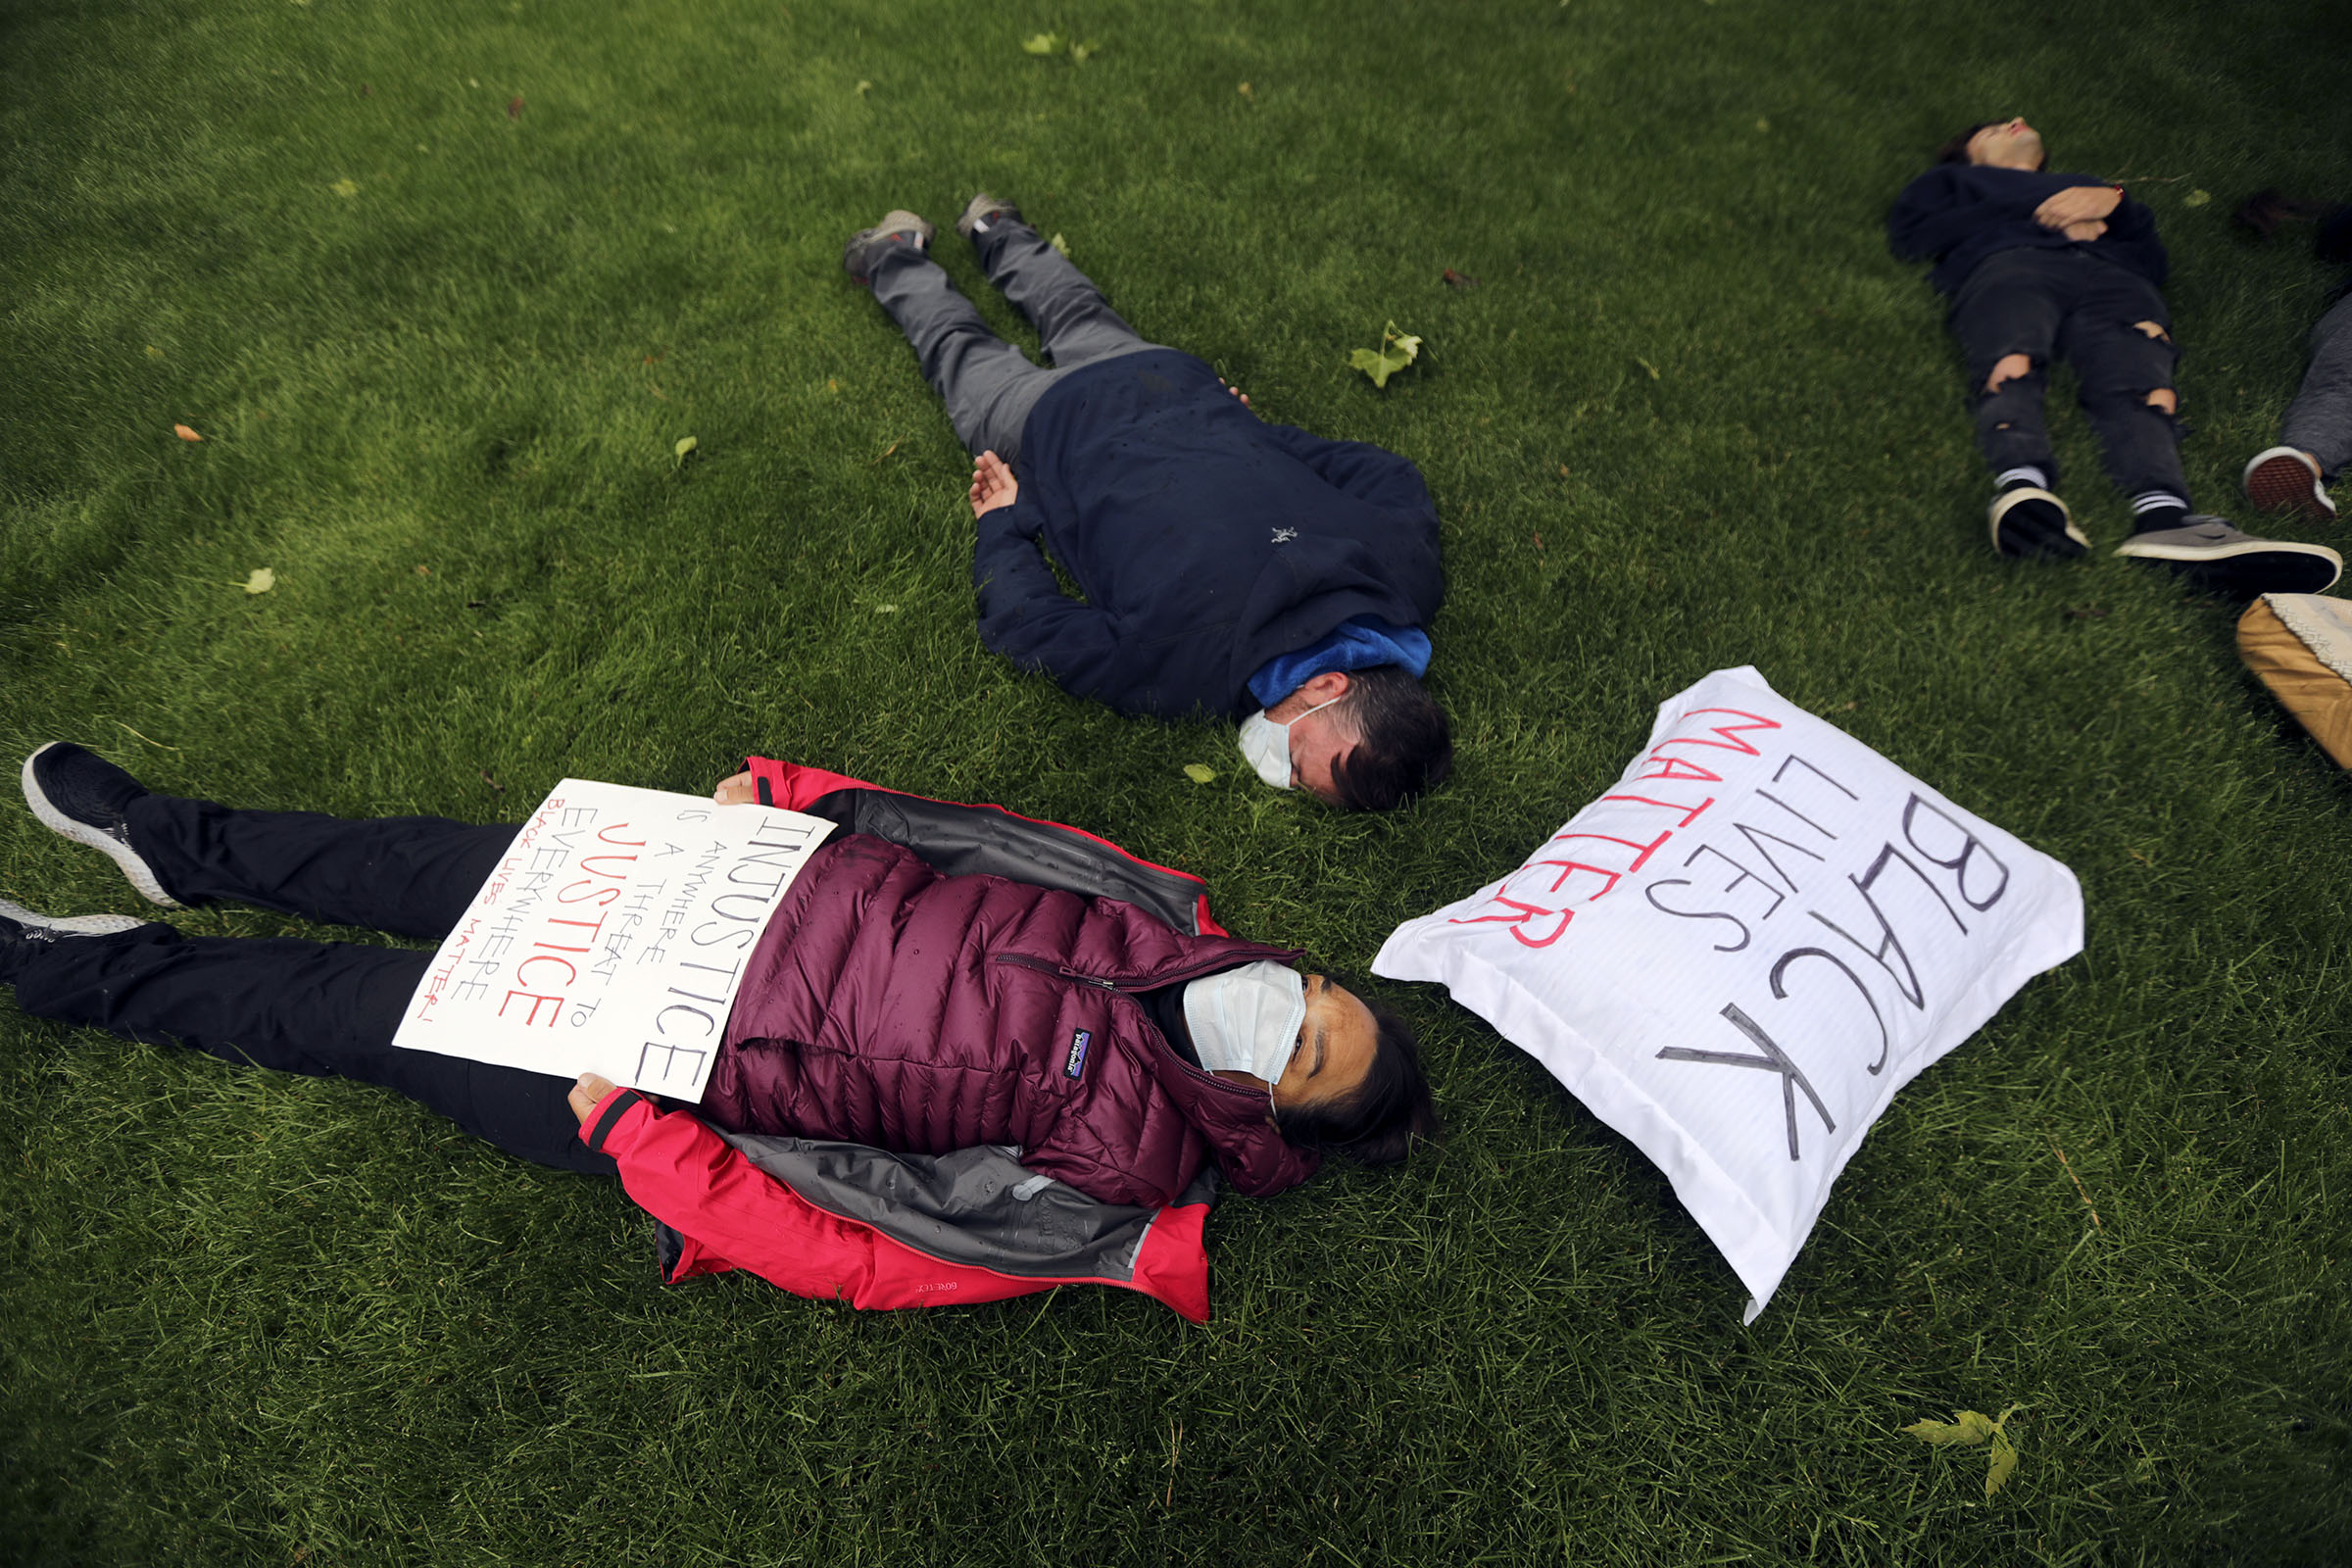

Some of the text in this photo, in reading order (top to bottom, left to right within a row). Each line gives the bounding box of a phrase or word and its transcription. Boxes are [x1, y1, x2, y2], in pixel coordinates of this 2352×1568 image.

[450, 807, 599, 1001] EVERYWHERE
[483, 858, 522, 906] LIVES
[519, 798, 565, 849] BLACK
[570, 808, 712, 1028] IS A THREAT TO
[636, 840, 728, 965] ANYWHERE
[1448, 707, 1782, 949] MATTER
[1645, 754, 1860, 953] LIVES
[498, 822, 647, 1028] JUSTICE
[634, 816, 816, 1086] INJUSTICE
[1655, 792, 2010, 1161] BLACK
[1067, 1033, 1082, 1073] patagonia
